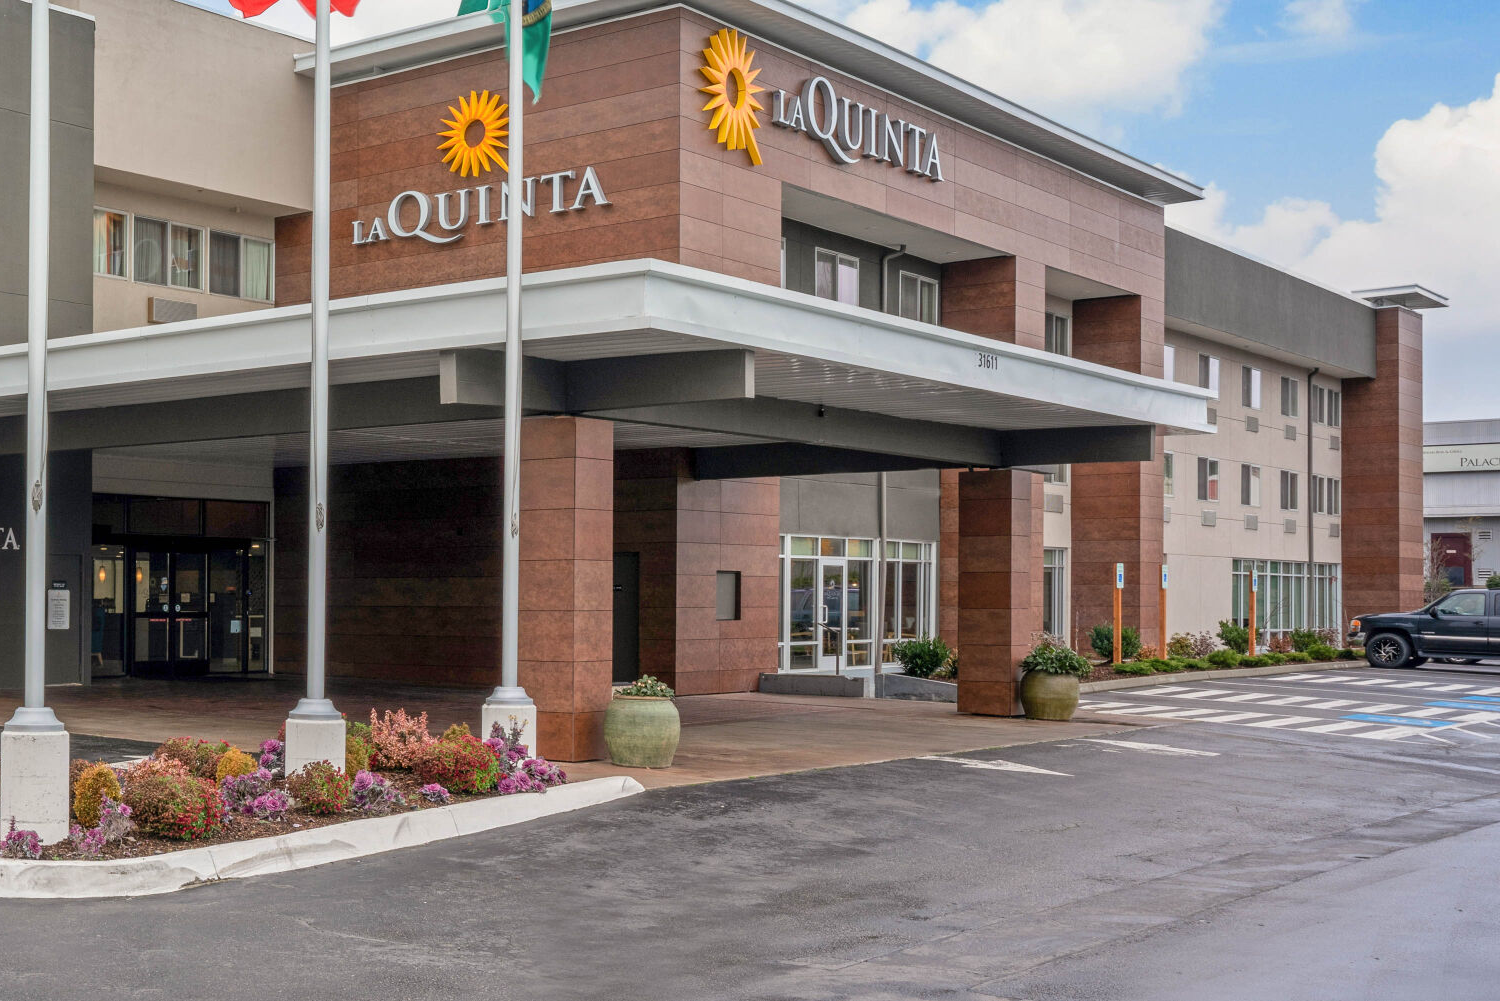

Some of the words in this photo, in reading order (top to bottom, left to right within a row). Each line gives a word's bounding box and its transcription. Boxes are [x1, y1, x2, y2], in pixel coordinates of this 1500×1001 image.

[801, 76, 945, 183] QUINTA
[387, 166, 613, 244] QUINTA
[978, 352, 998, 370] 31611
